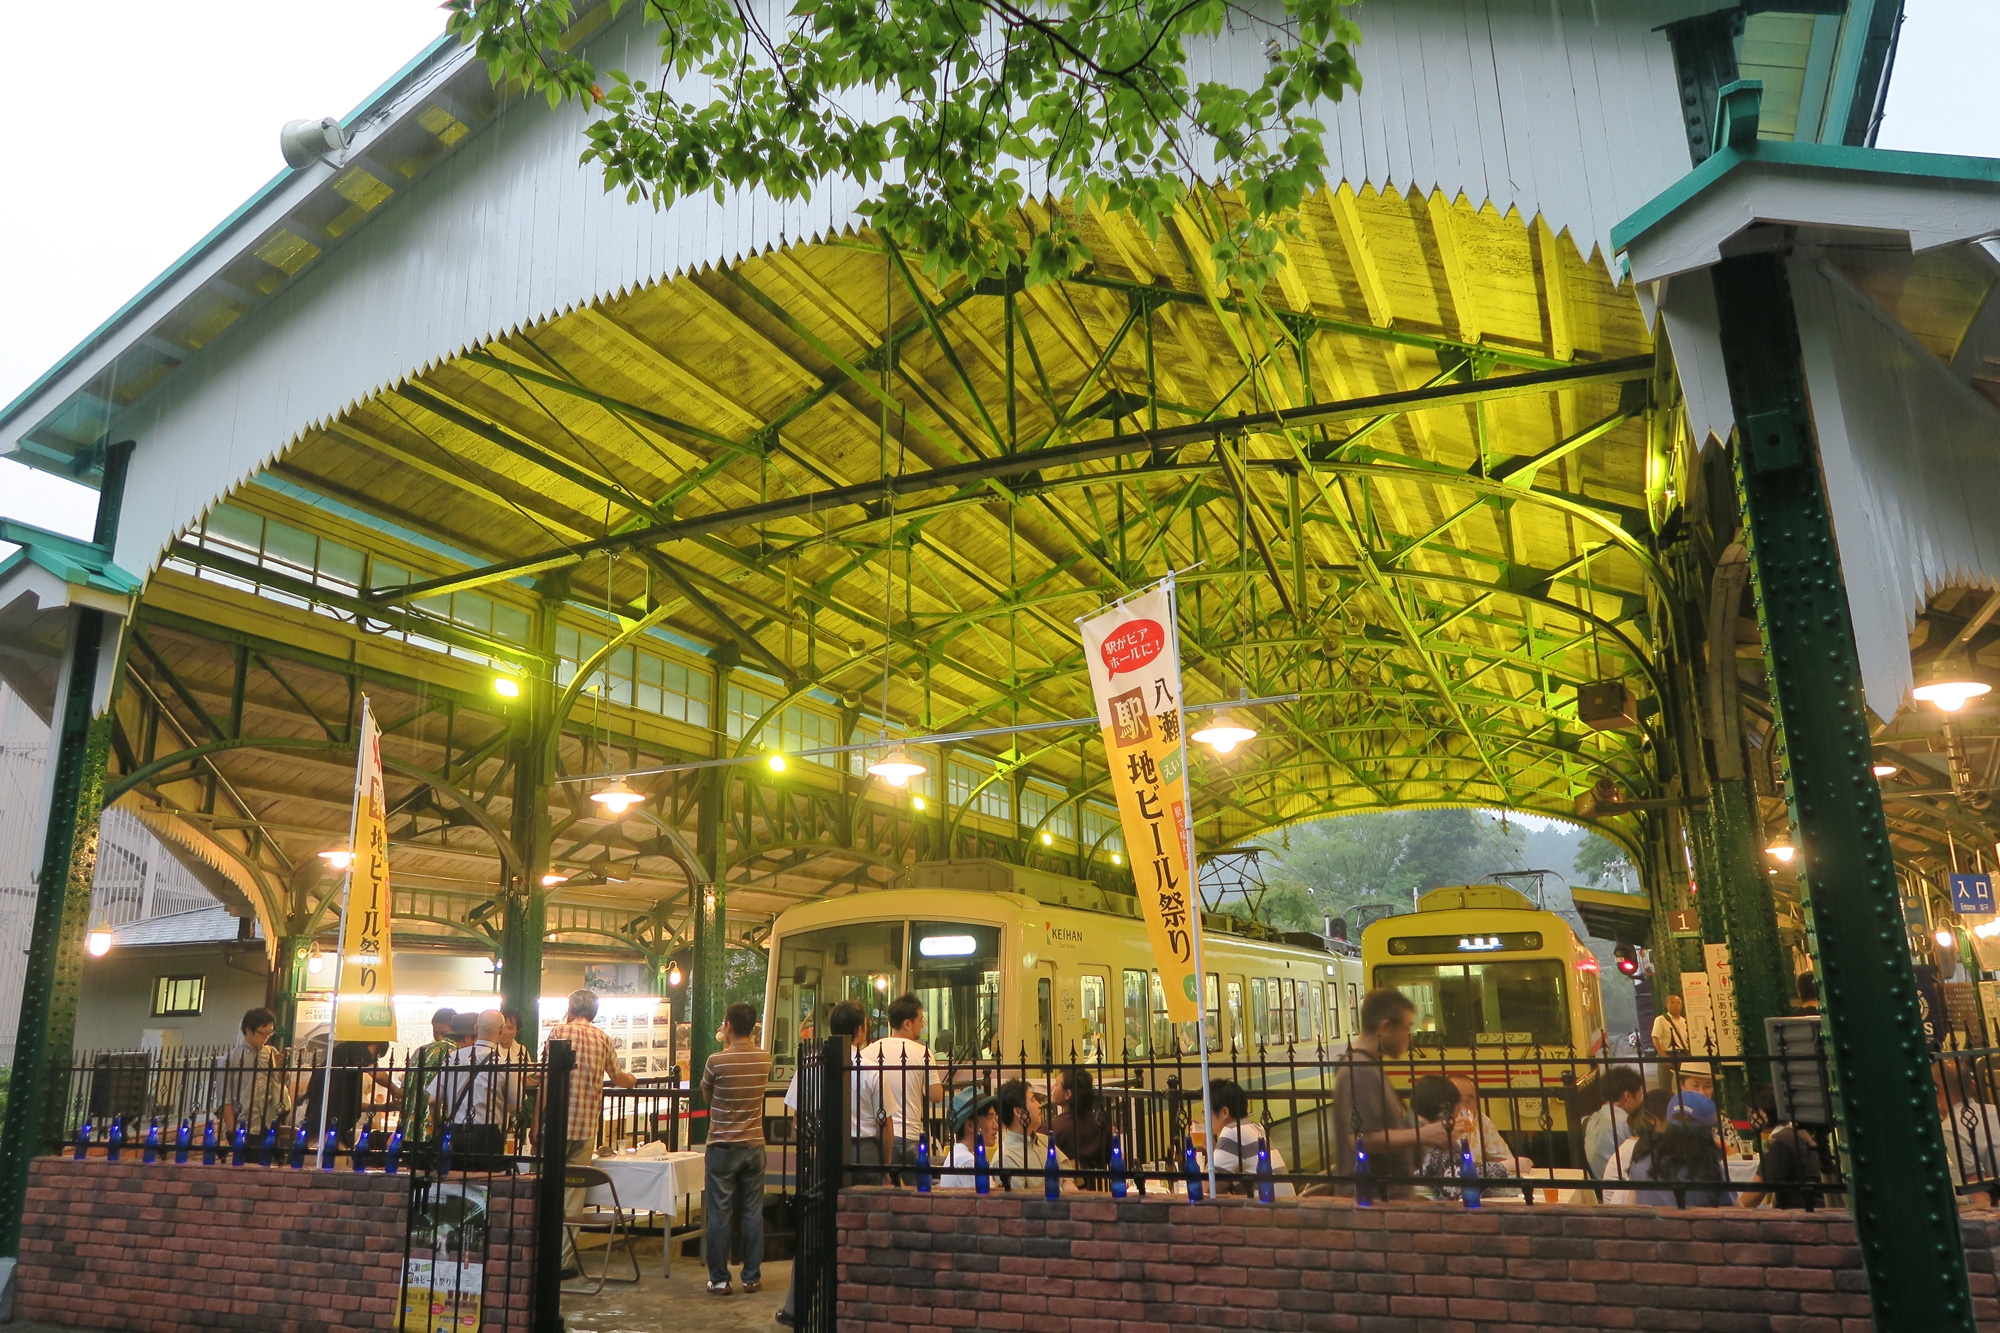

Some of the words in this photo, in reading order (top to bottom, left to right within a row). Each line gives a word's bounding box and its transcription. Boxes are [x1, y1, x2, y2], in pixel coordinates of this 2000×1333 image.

[1104, 627, 1149, 655] 駅がビア
[1153, 676, 1180, 744] 八瀬
[1114, 696, 1191, 964] 駅地ビール祭り
[1957, 880, 1988, 899] 入口
[1677, 913, 1690, 930] 1
[1051, 928, 1083, 942] KEIHAN
